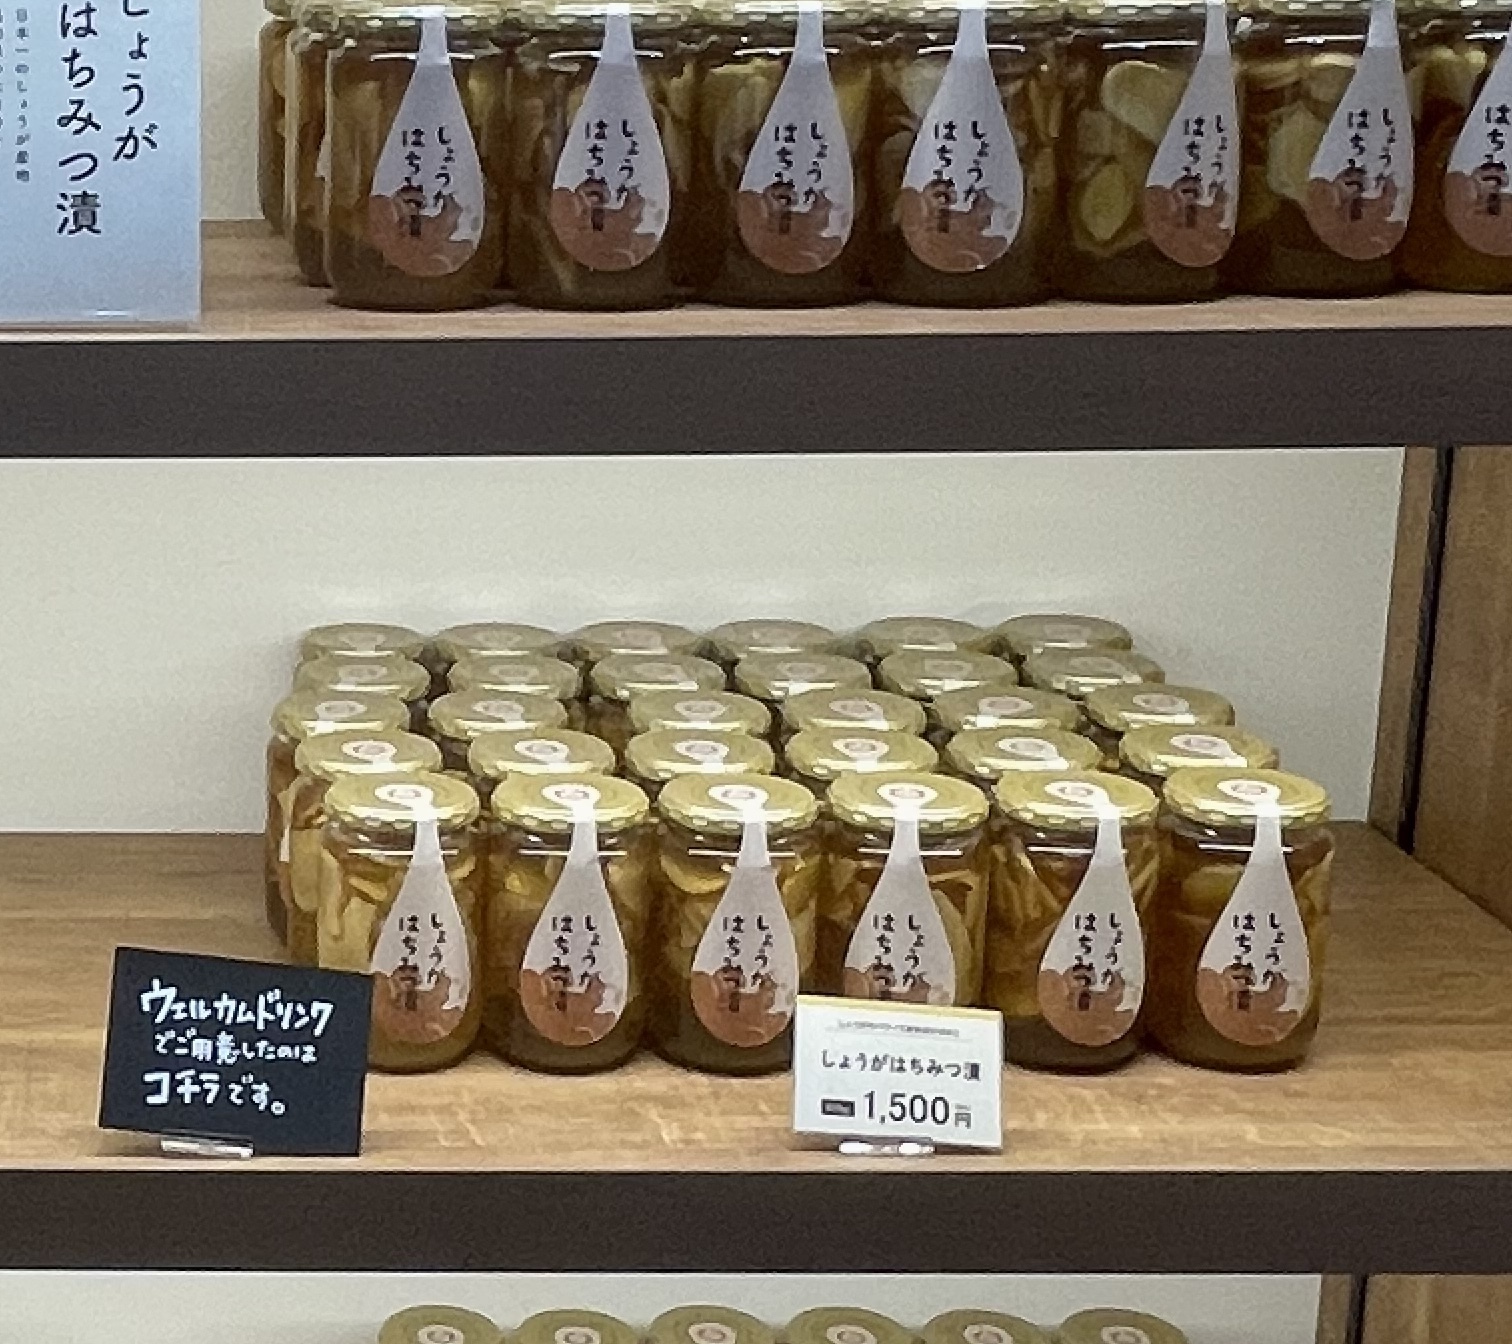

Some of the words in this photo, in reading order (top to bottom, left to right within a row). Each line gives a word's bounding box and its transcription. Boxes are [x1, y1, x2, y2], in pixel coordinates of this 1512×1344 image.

[56, 1, 102, 236] はちみつ漬
[140, 977, 334, 1037] ウェルカムドリンク
[154, 1027, 318, 1066] でご用意したのは
[143, 1068, 286, 1116] コチラです。
[863, 1090, 972, 1129] 1,500円
